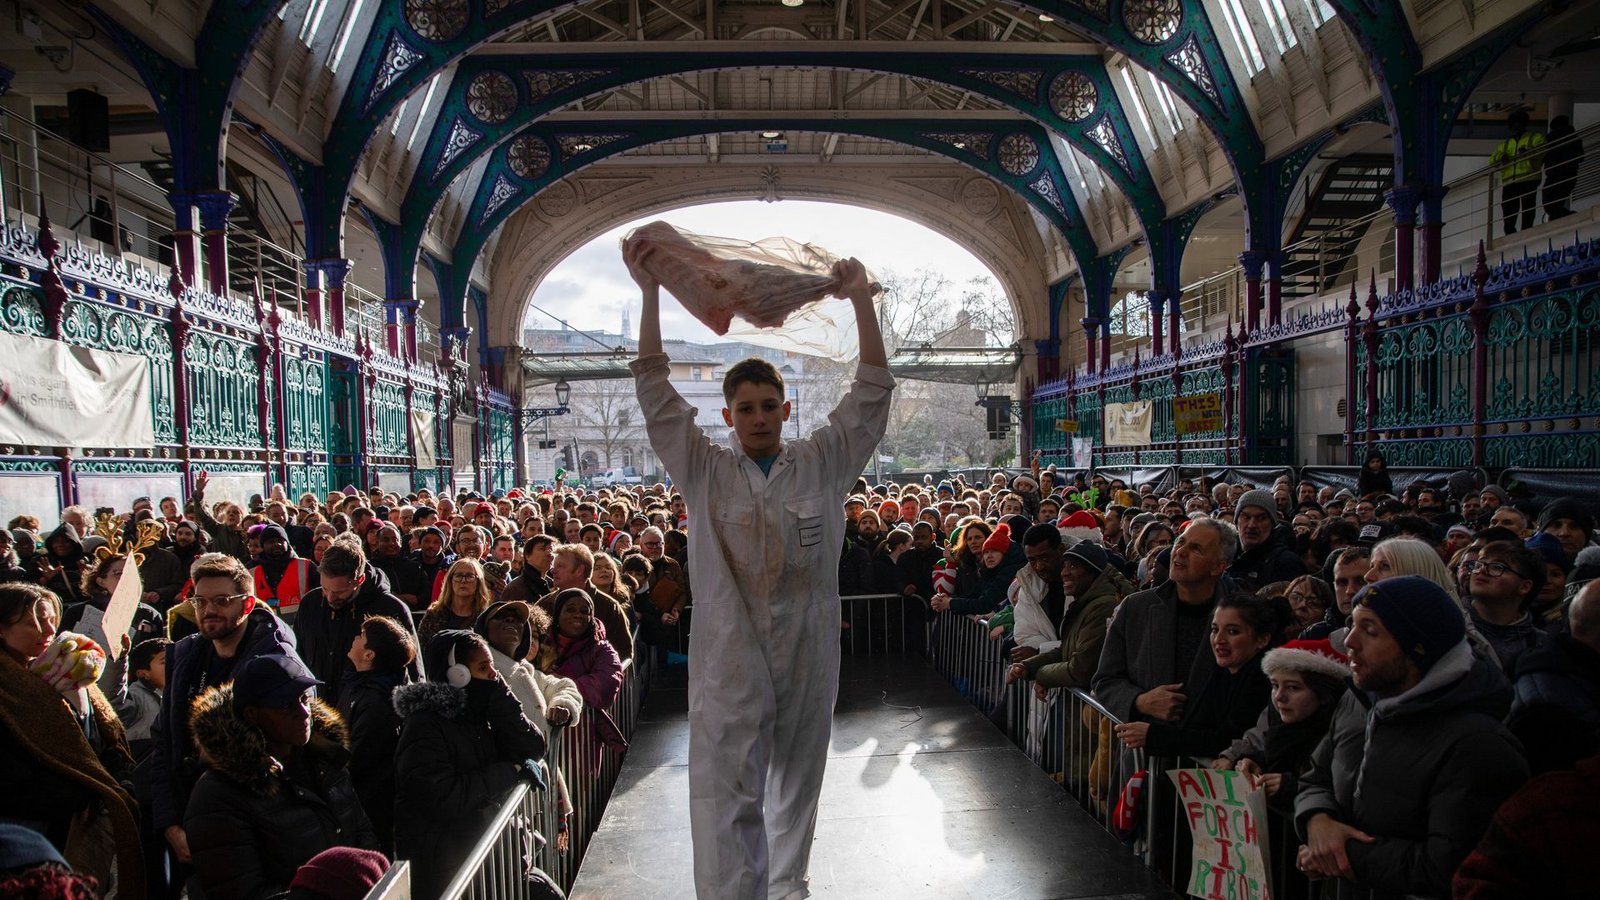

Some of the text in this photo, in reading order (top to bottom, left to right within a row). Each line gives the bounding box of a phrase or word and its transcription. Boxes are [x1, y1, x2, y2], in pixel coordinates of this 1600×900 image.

[16, 391, 27, 405] in
[1175, 397, 1216, 412] THIS
[198, 671, 207, 694] SONY
[1186, 801, 1229, 839] FOR
[1214, 837, 1248, 876] IS
